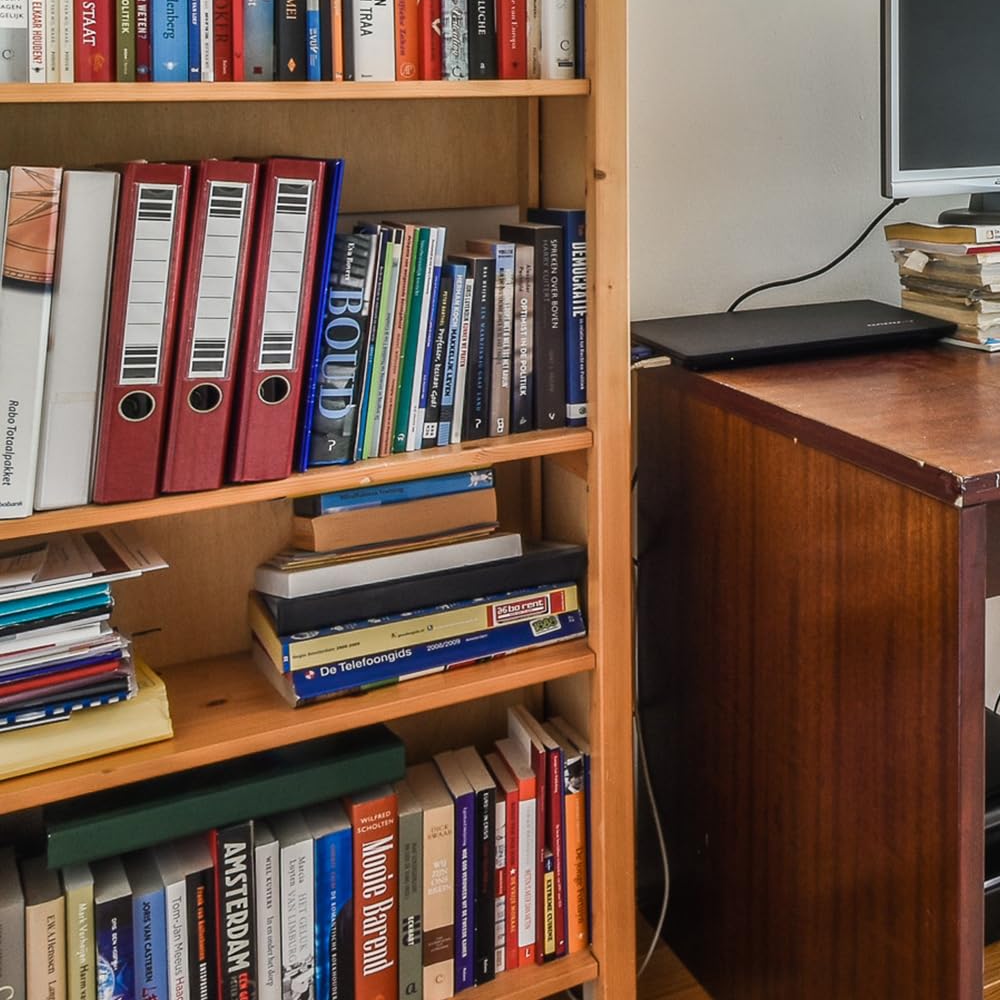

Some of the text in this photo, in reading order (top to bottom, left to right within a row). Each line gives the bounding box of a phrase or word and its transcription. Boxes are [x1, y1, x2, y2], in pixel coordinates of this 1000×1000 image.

[32, 1, 42, 28] ELKAAR
[82, 2, 96, 46] STAAT
[359, 7, 372, 36] TRAA
[33, 30, 42, 63] HOUDEN?
[347, 242, 355, 256] Eva
[550, 239, 558, 274] SPREKEN
[571, 242, 587, 317] DEMOCRATIE
[551, 301, 559, 329] BOVEN
[444, 274, 462, 397] HERMAN KOCH MAKKELIJK LEVEN
[519, 298, 527, 396] OPTIMIST IN DE POLITIEK
[319, 287, 364, 420] BOUD
[3, 400, 19, 486] Rabo Totaalpakket
[320, 664, 337, 677] De
[339, 648, 412, 674] Telefoongids
[357, 819, 394, 833] SCHOLTEN
[360, 811, 391, 824] WILFRED
[224, 842, 250, 973] AMSTERDAM
[287, 860, 297, 963] Luyten VAN LIMBURG
[298, 856, 308, 952] Marcia HET GELUK
[331, 891, 336, 901] DE
[362, 834, 394, 976] Mooie Barend
[171, 896, 183, 940] Tom-Jan
[266, 915, 274, 924] In
[266, 926, 272, 935] en
[407, 916, 415, 946] ECKHART
[78, 903, 88, 988] Mark Harm
[142, 901, 152, 983] JORIS VAN CASTEREN
[174, 943, 184, 975] Meeus
[263, 969, 275, 987] dorp
